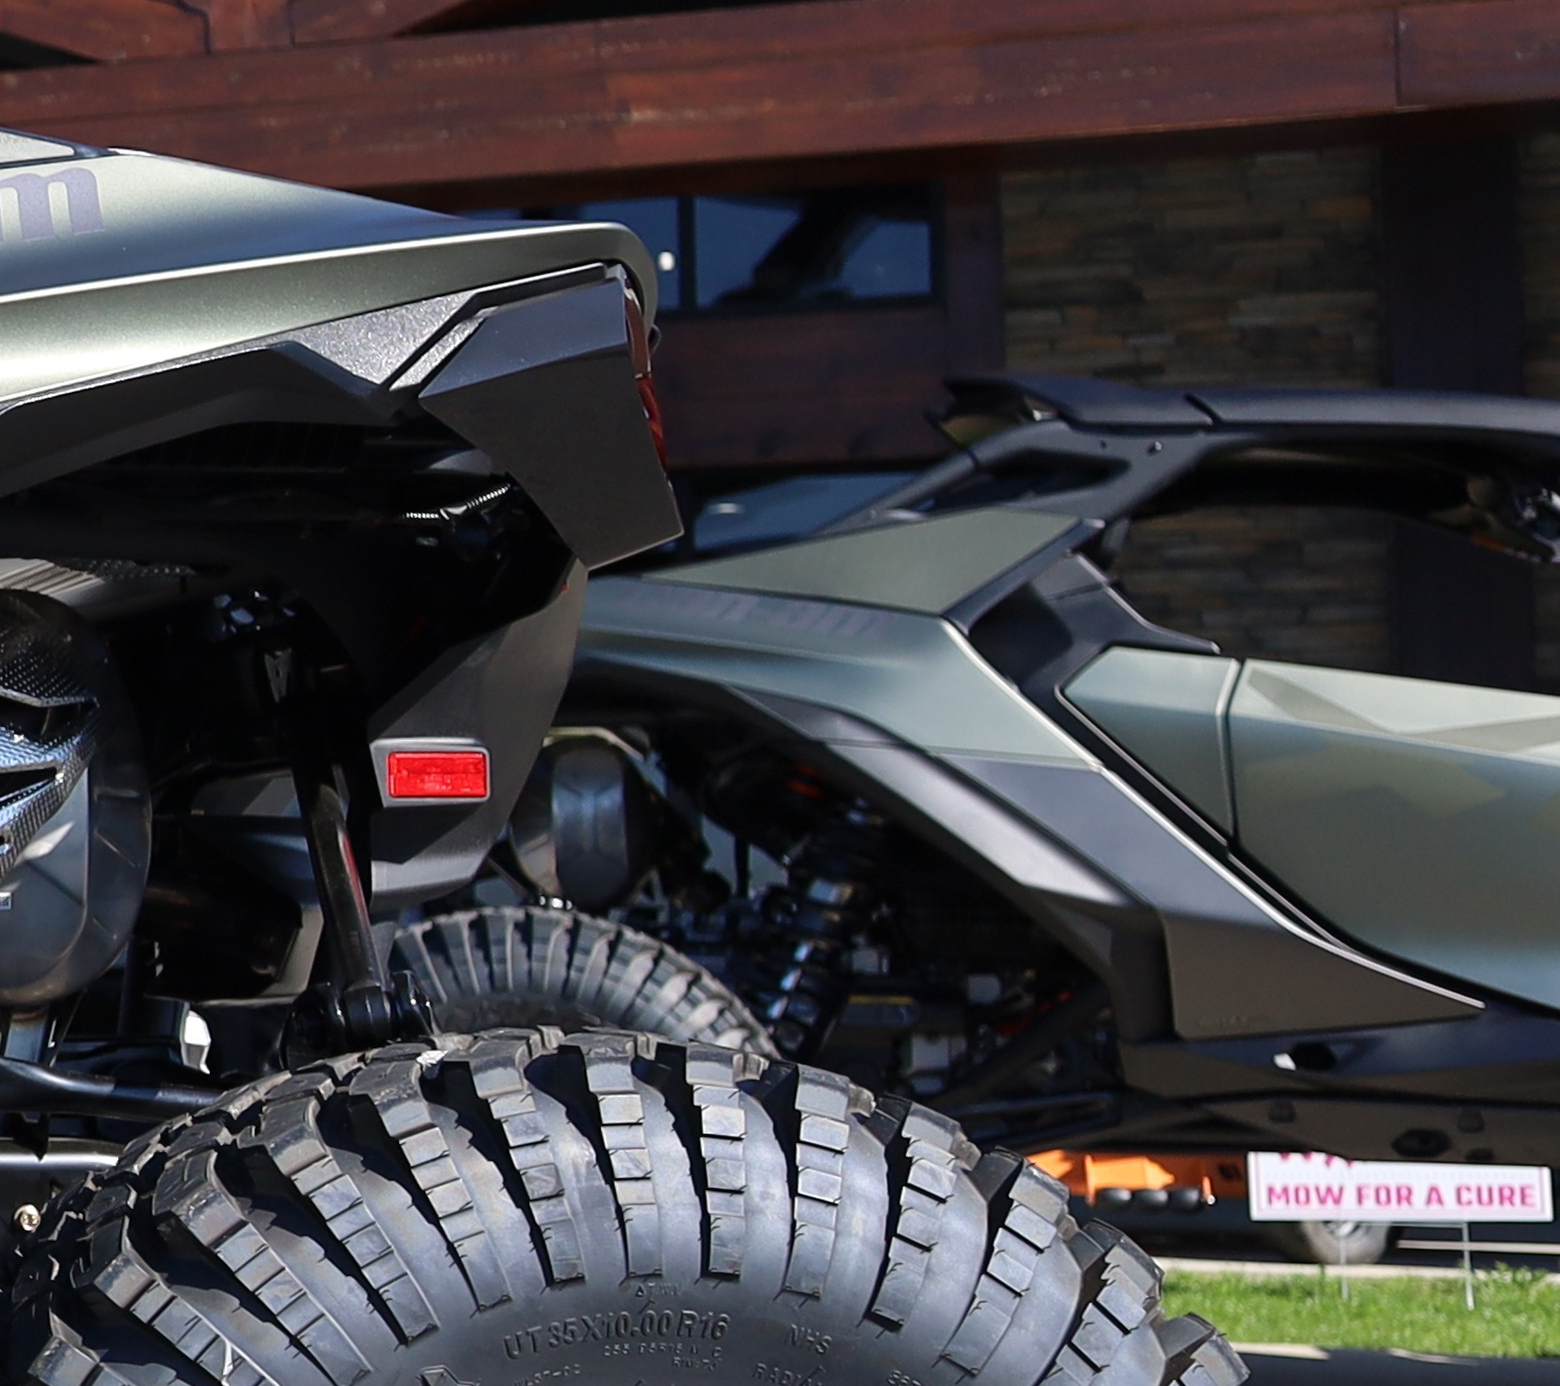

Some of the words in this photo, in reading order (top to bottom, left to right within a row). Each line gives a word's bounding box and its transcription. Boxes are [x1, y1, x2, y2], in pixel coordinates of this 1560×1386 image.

[1266, 1184, 1344, 1206] MOW
[1357, 1185, 1412, 1206] FOR
[1425, 1185, 1443, 1206] A
[1456, 1184, 1536, 1207] CURE
[499, 1323, 548, 1362] UT
[784, 1322, 834, 1357] NHS
